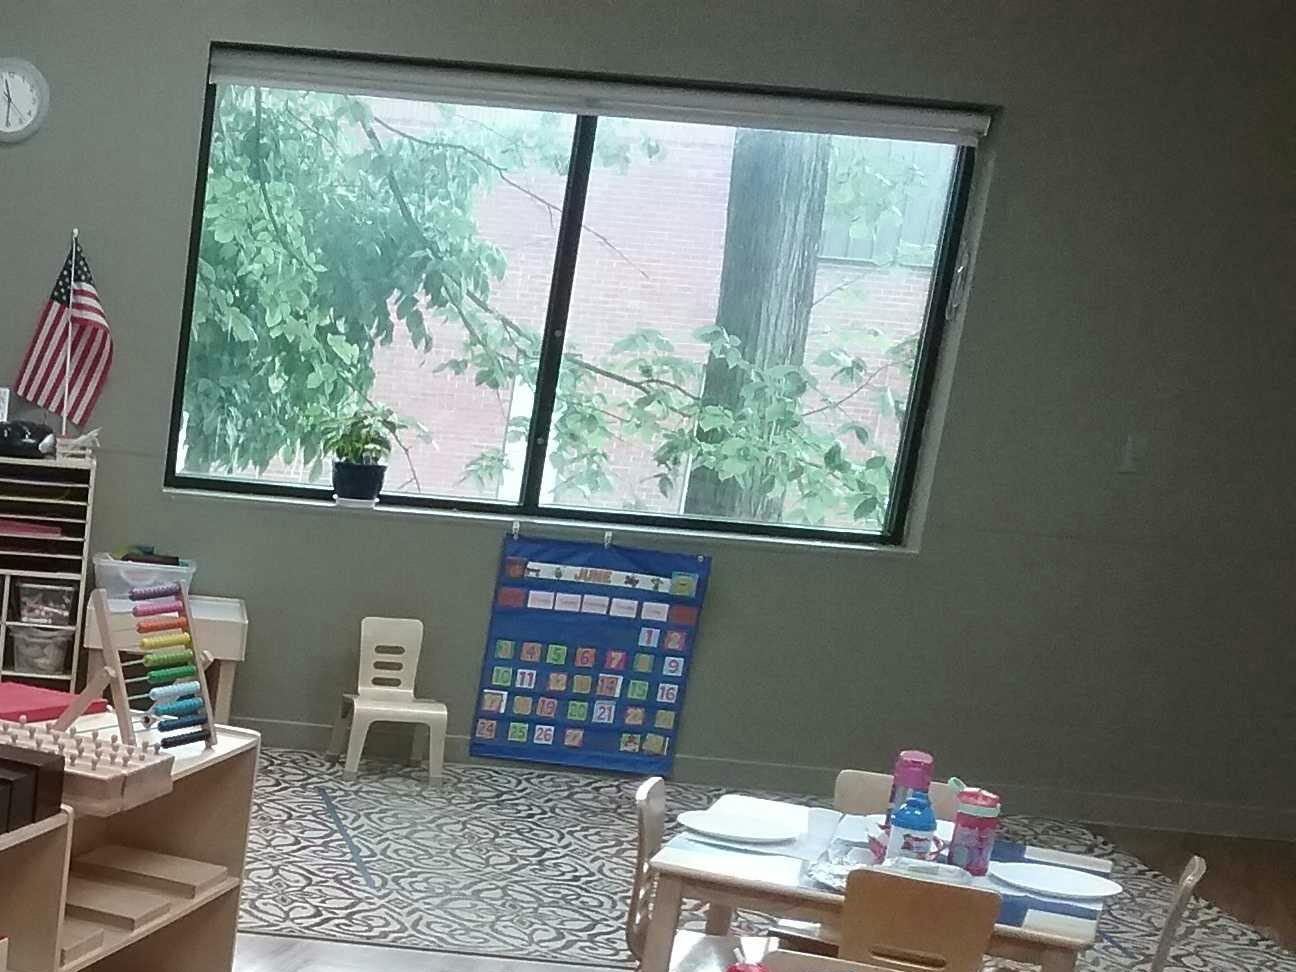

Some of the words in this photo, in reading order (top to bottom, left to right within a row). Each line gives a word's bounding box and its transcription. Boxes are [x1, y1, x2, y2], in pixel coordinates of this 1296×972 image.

[575, 567, 613, 584] JUNE
[669, 632, 681, 649] 2
[553, 647, 564, 662] 5
[580, 650, 592, 664] 6
[610, 651, 623, 668] 7
[668, 659, 679, 673] 9
[495, 668, 510, 685] 10
[518, 671, 534, 687] 11
[659, 687, 676, 701] 16
[569, 703, 586, 717] 20
[598, 705, 613, 721] 21
[511, 724, 526, 739] 25
[535, 726, 552, 741] 26
